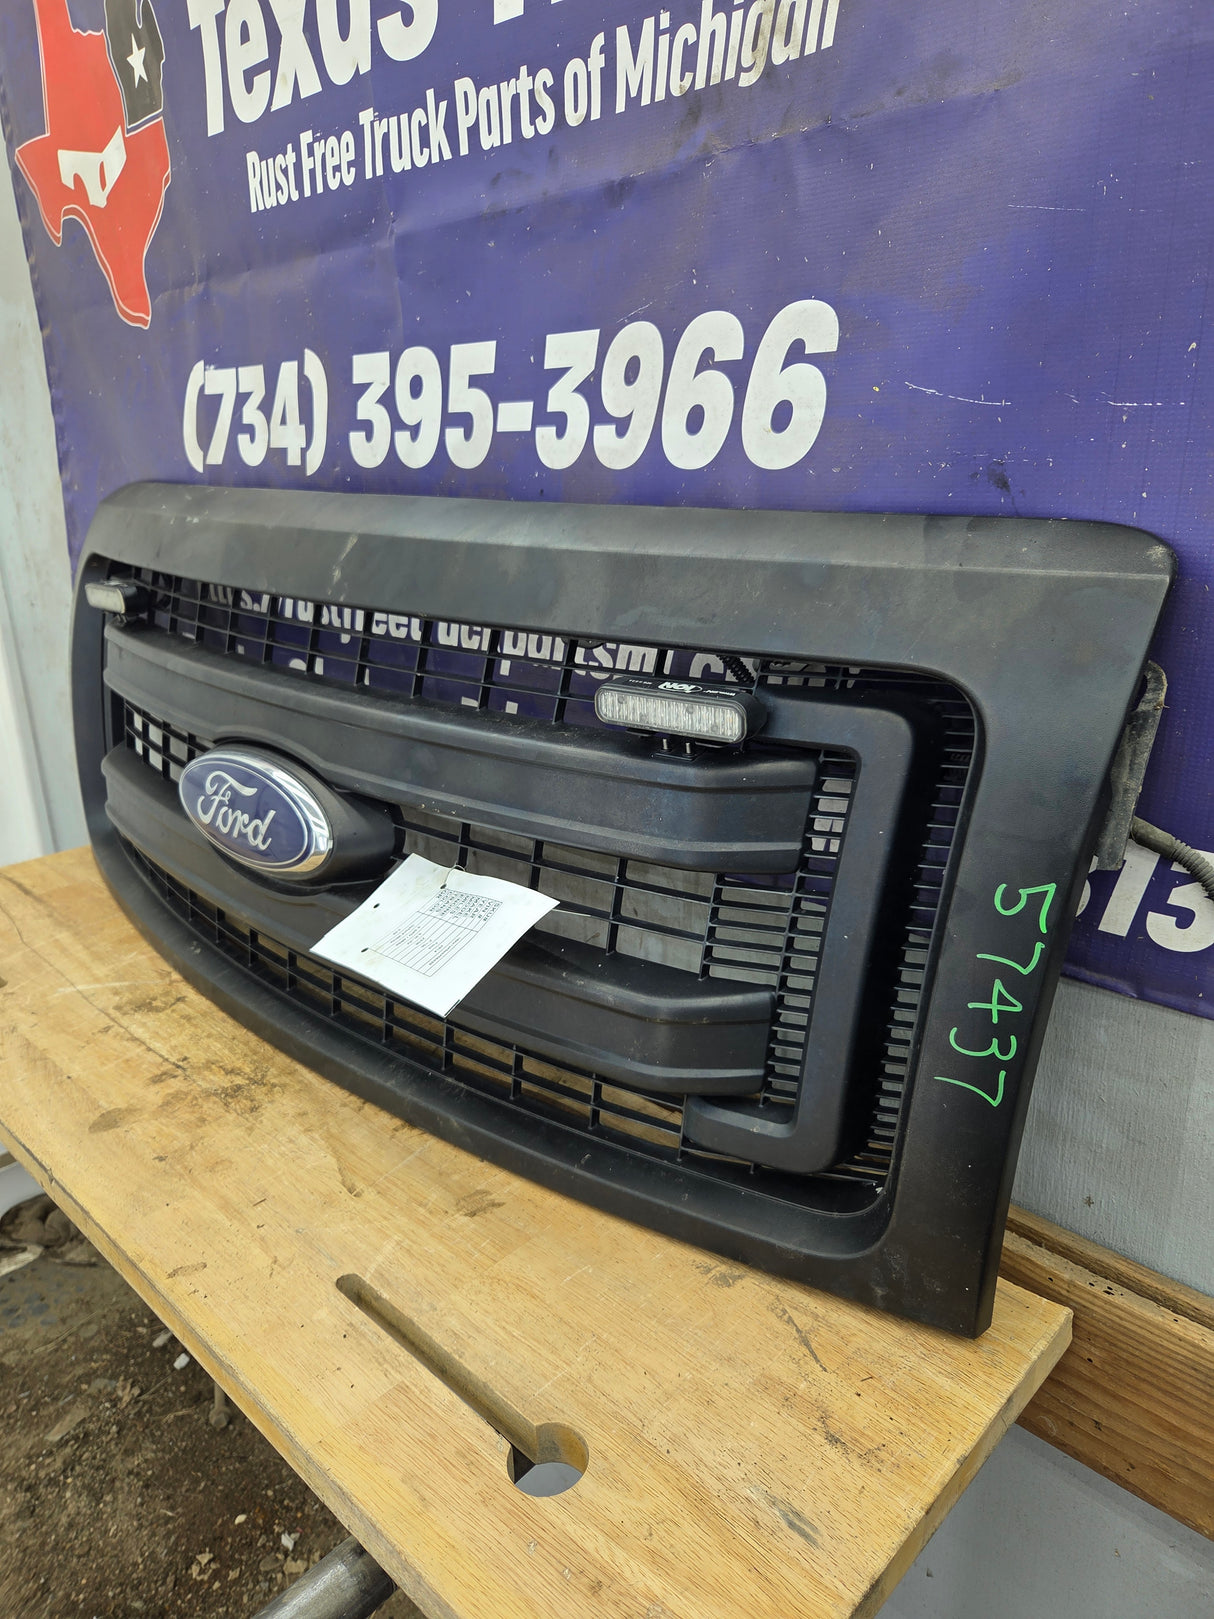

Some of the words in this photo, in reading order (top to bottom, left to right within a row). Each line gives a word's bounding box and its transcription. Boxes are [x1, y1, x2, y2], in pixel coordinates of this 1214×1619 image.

[246, 145, 299, 213] Rust
[299, 125, 356, 198] Free
[359, 88, 453, 178] Truck
[453, 65, 555, 157] Parts
[564, 32, 606, 127] of
[615, 0, 841, 113] Michigan
[183, 348, 328, 477] (734)
[349, 299, 839, 471] 395-3966
[197, 770, 276, 851] Ford
[934, 882, 1056, 1107] 57437
